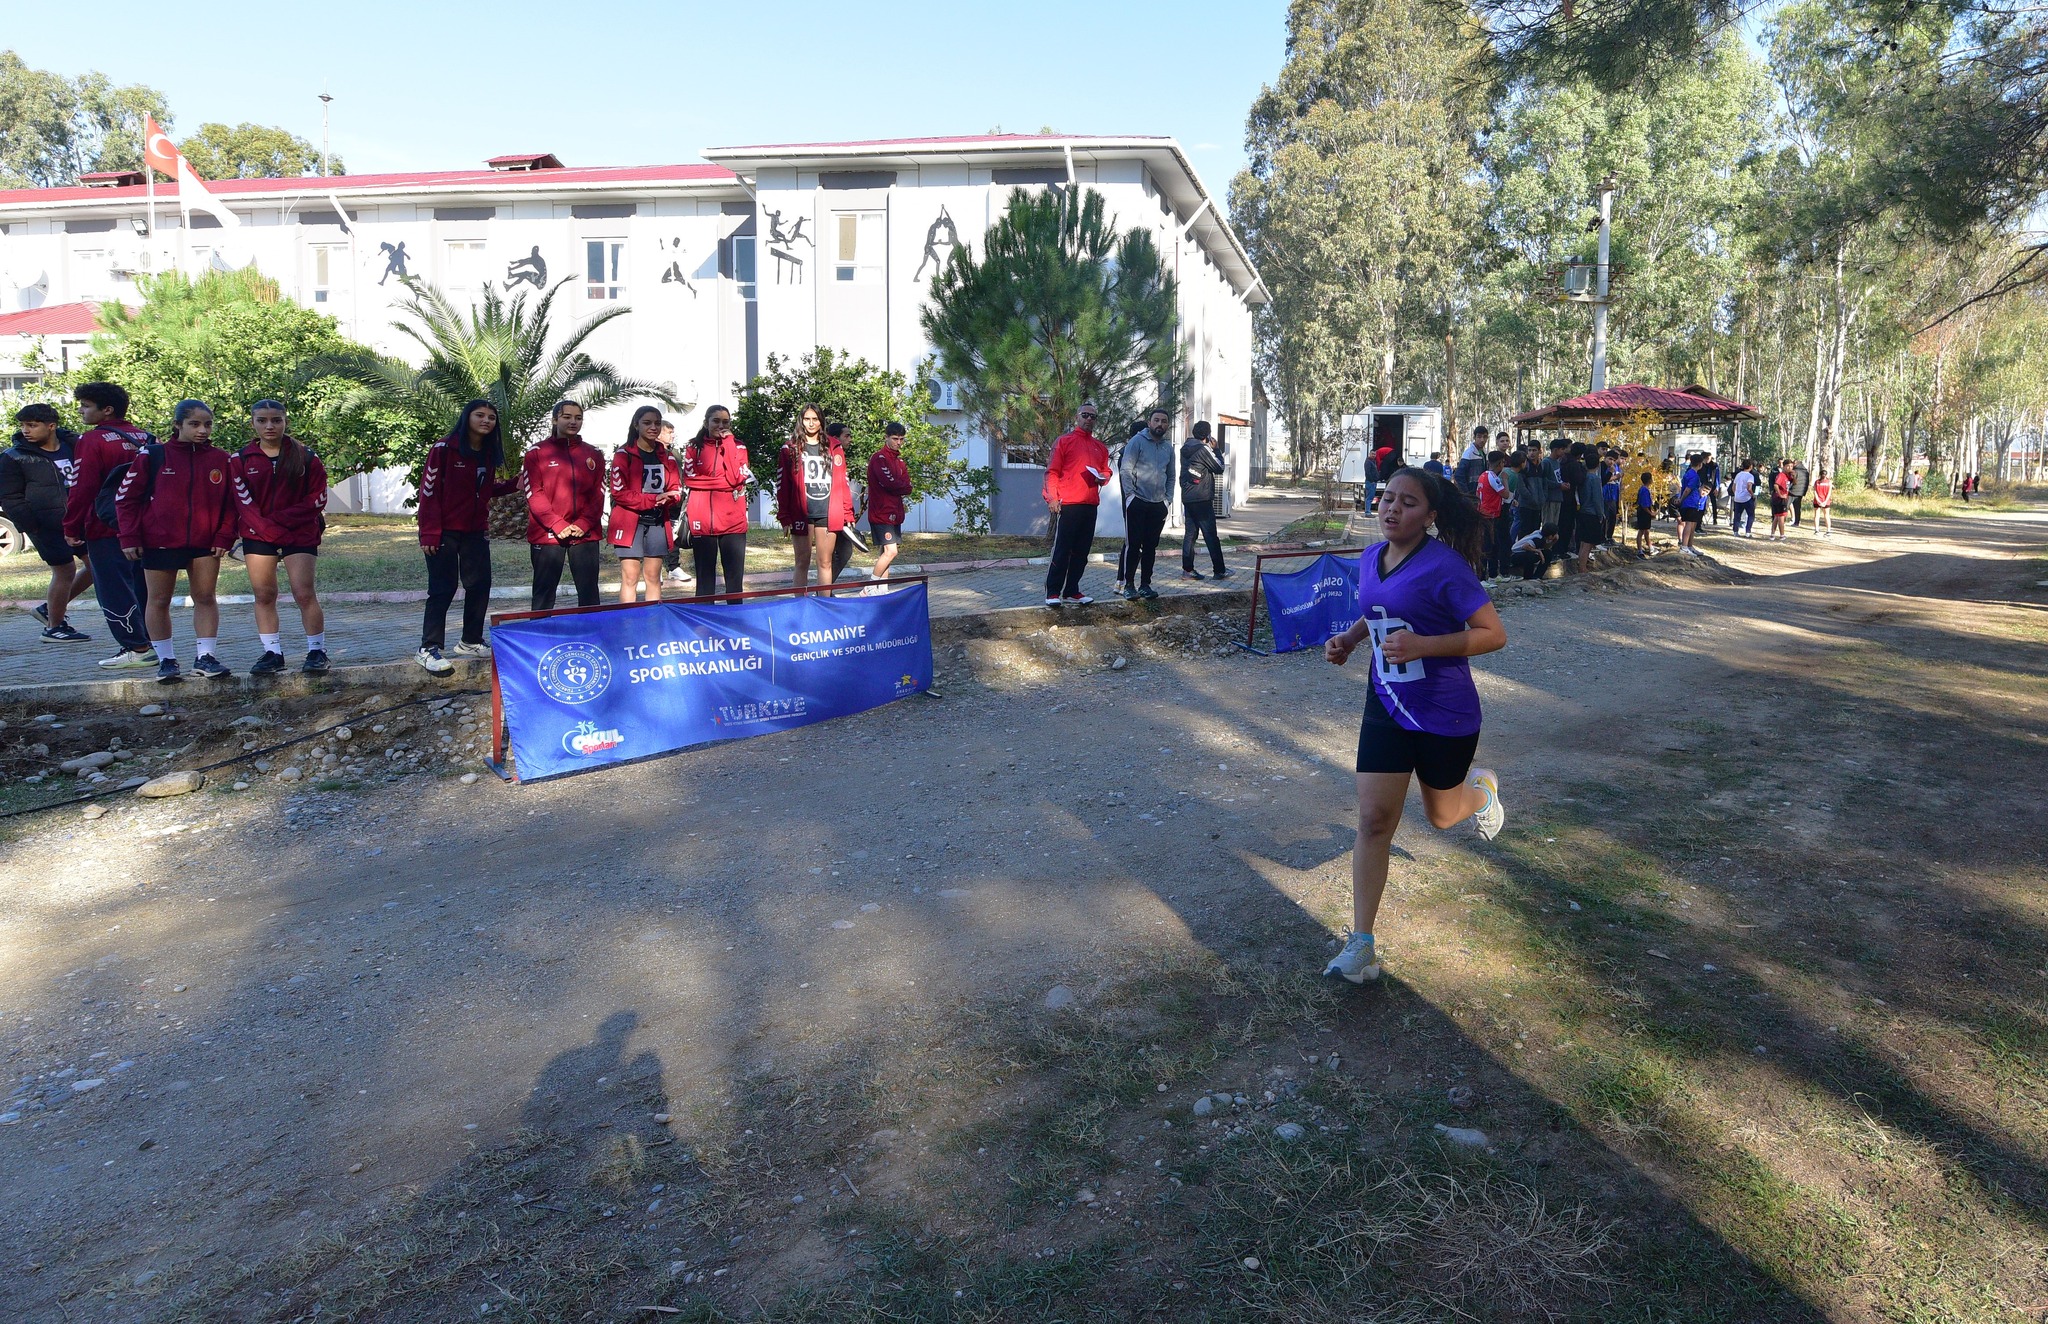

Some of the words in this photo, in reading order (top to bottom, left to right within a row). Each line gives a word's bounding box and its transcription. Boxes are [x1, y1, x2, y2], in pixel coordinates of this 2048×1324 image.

[615, 529, 624, 540] 11
[692, 520, 701, 530] 15
[795, 521, 805, 530] 27
[788, 624, 867, 646] OSMANİYE
[623, 644, 655, 660] T.C.
[656, 636, 726, 658] GENÇLİK
[728, 637, 752, 651] VE
[790, 648, 830, 662] GENÇLİK
[831, 648, 844, 657] VE
[845, 643, 867, 656] SPOR
[867, 642, 875, 652] İL
[875, 634, 918, 651] MÜDÜRLÜĞÜ
[629, 664, 676, 684] SPOR
[677, 654, 763, 676] BAKANLIĞI
[719, 696, 805, 721] TÜRKİYE
[571, 728, 625, 751] OKUL
